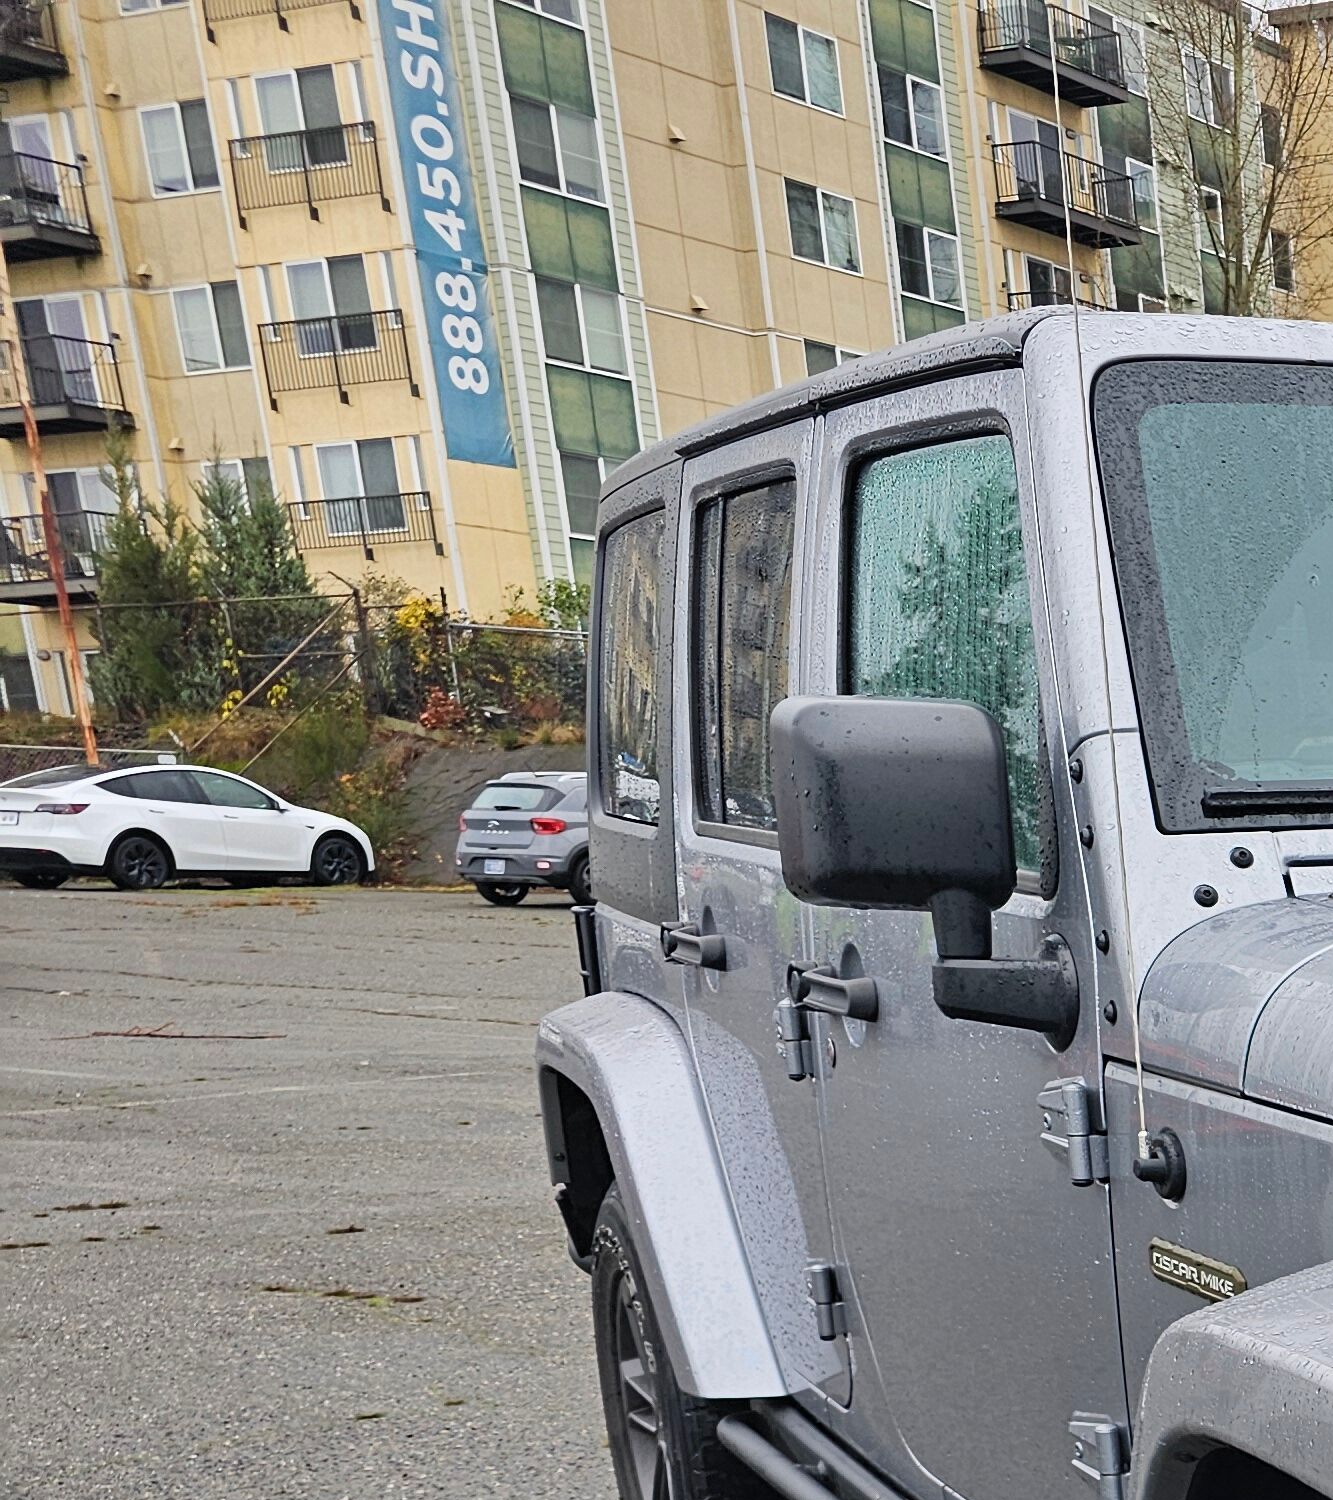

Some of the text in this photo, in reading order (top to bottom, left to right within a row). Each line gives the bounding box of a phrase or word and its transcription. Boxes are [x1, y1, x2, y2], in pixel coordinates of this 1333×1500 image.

[391, 0, 489, 396] 888.450.SH
[1152, 1251, 1235, 1297] OSCAR MIKE
